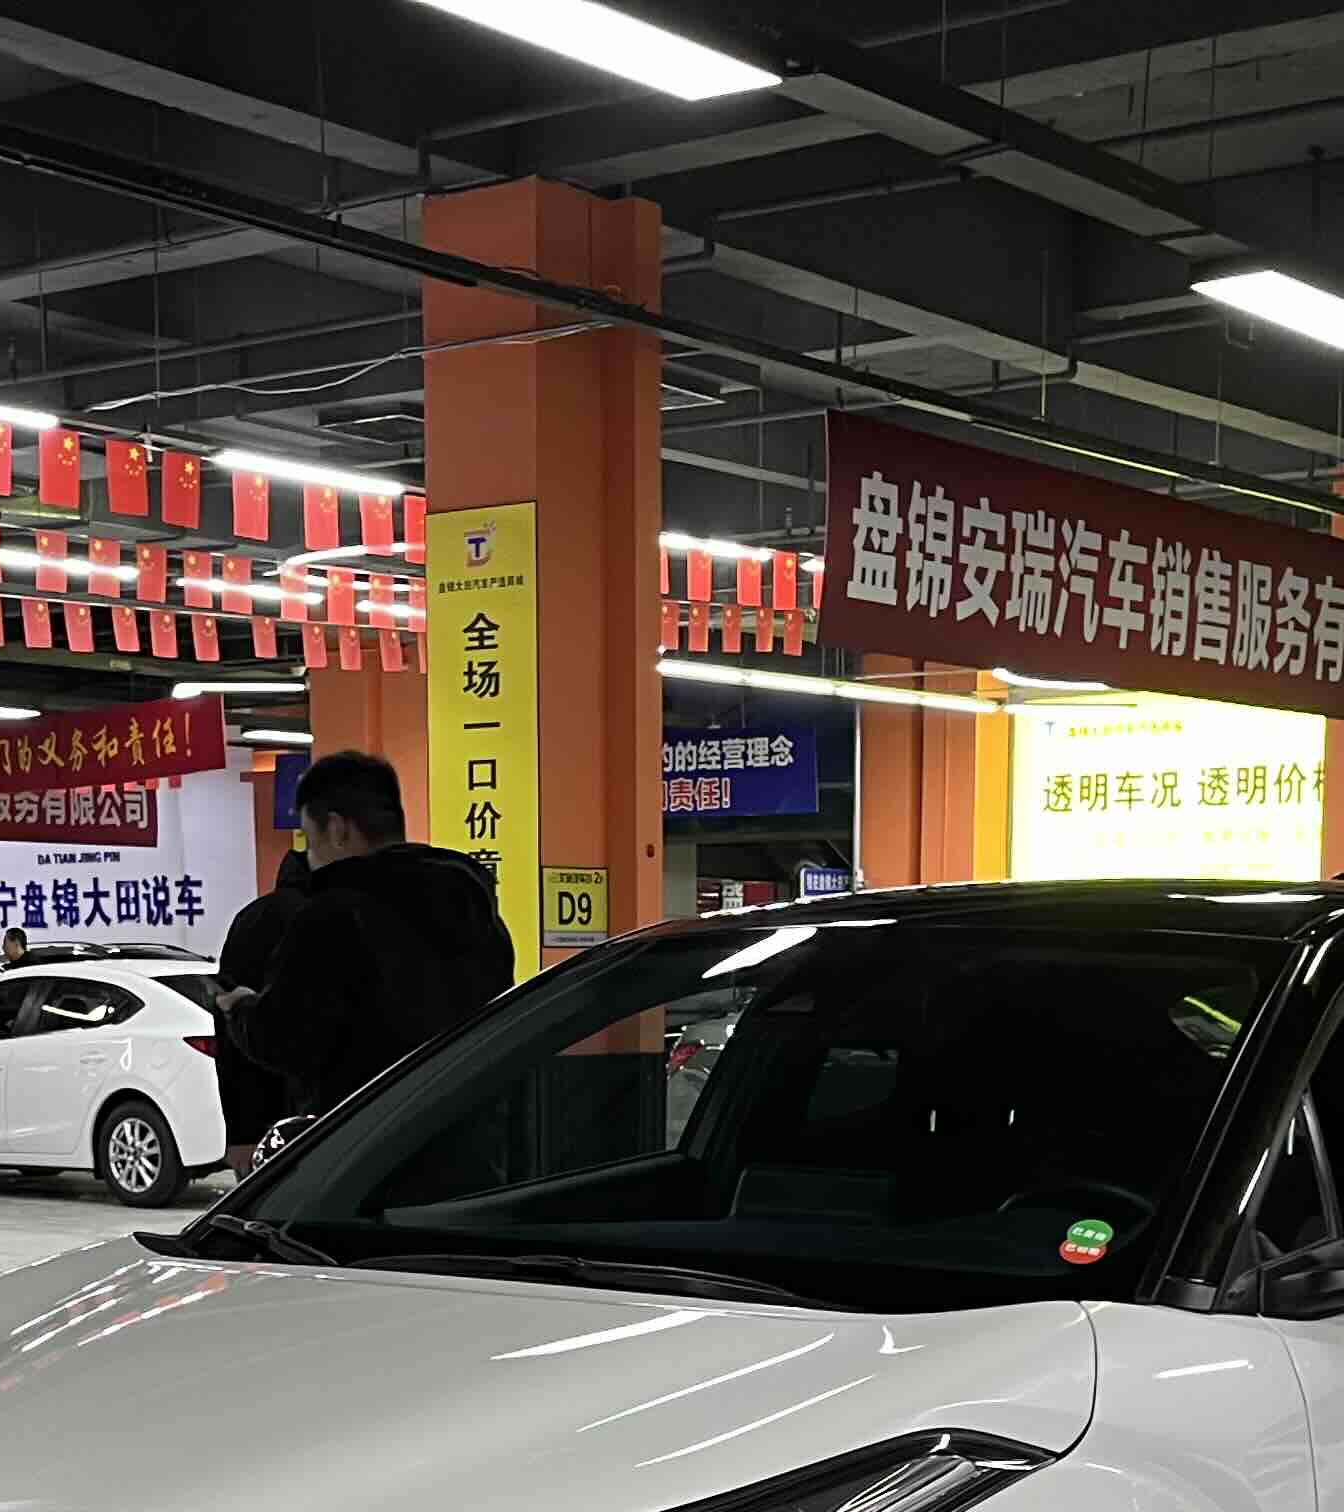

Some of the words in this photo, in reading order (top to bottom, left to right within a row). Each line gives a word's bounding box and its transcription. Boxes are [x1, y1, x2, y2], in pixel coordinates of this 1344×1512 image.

[662, 777, 731, 812] 责任!
[1043, 770, 1182, 812] 透明车况
[558, 892, 592, 925] D9
